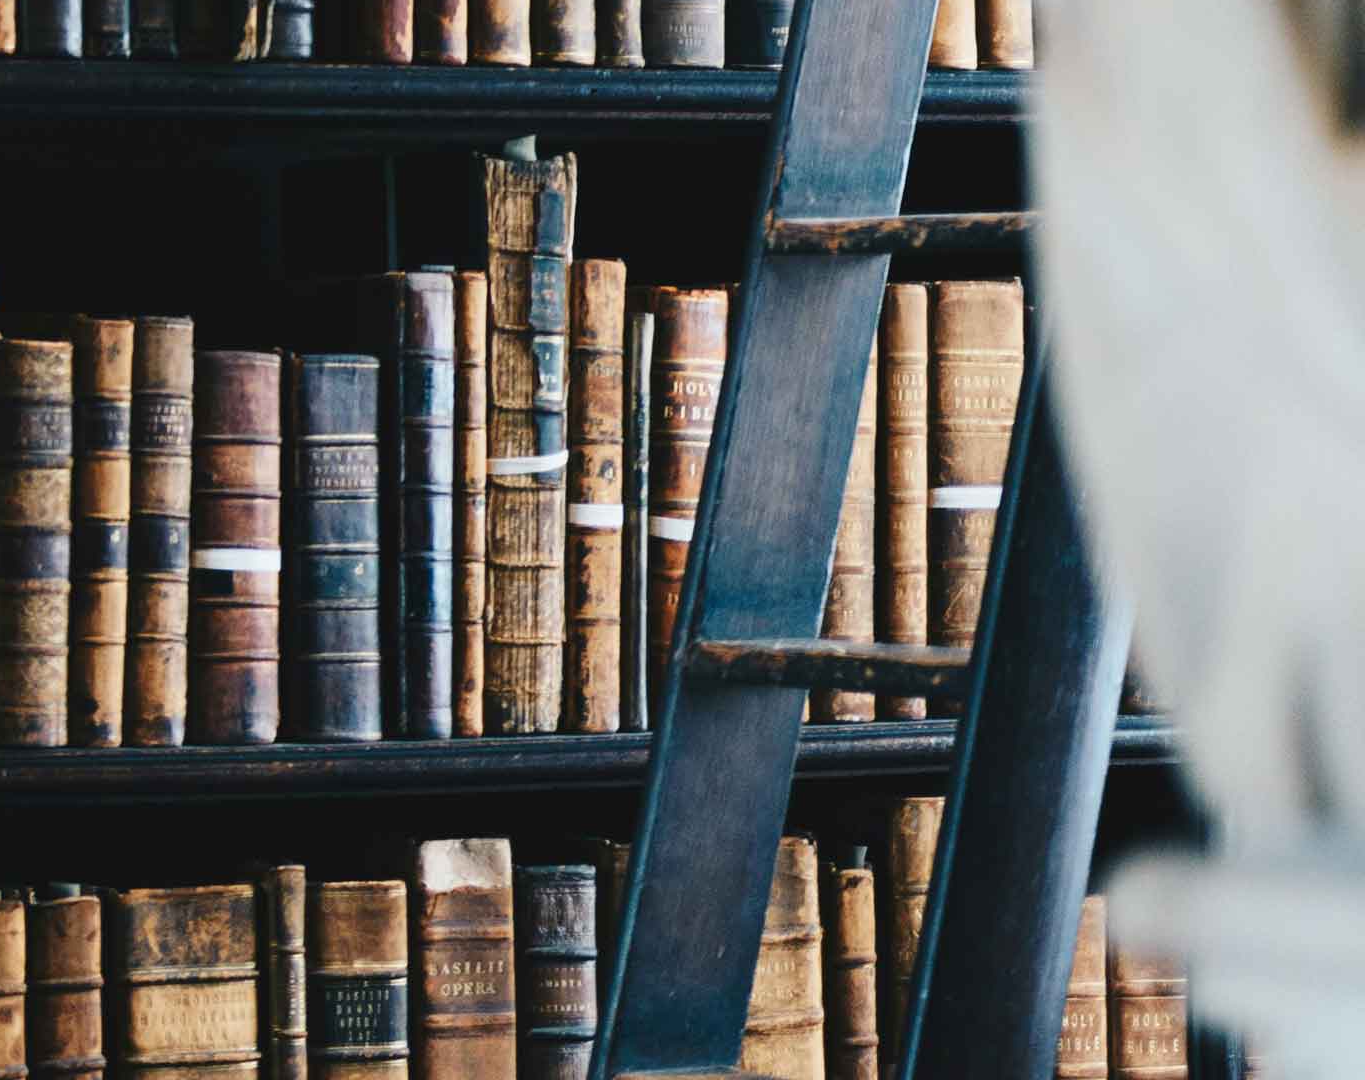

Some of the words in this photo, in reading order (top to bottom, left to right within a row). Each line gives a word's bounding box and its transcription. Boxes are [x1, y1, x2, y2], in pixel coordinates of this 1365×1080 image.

[672, 381, 717, 397] HOLY
[664, 405, 712, 420] BIBL
[440, 980, 496, 997] OPERA
[1062, 1012, 1096, 1028] HOLY
[1131, 1012, 1176, 1027] HOLY
[1126, 1037, 1180, 1055] BIBLE
